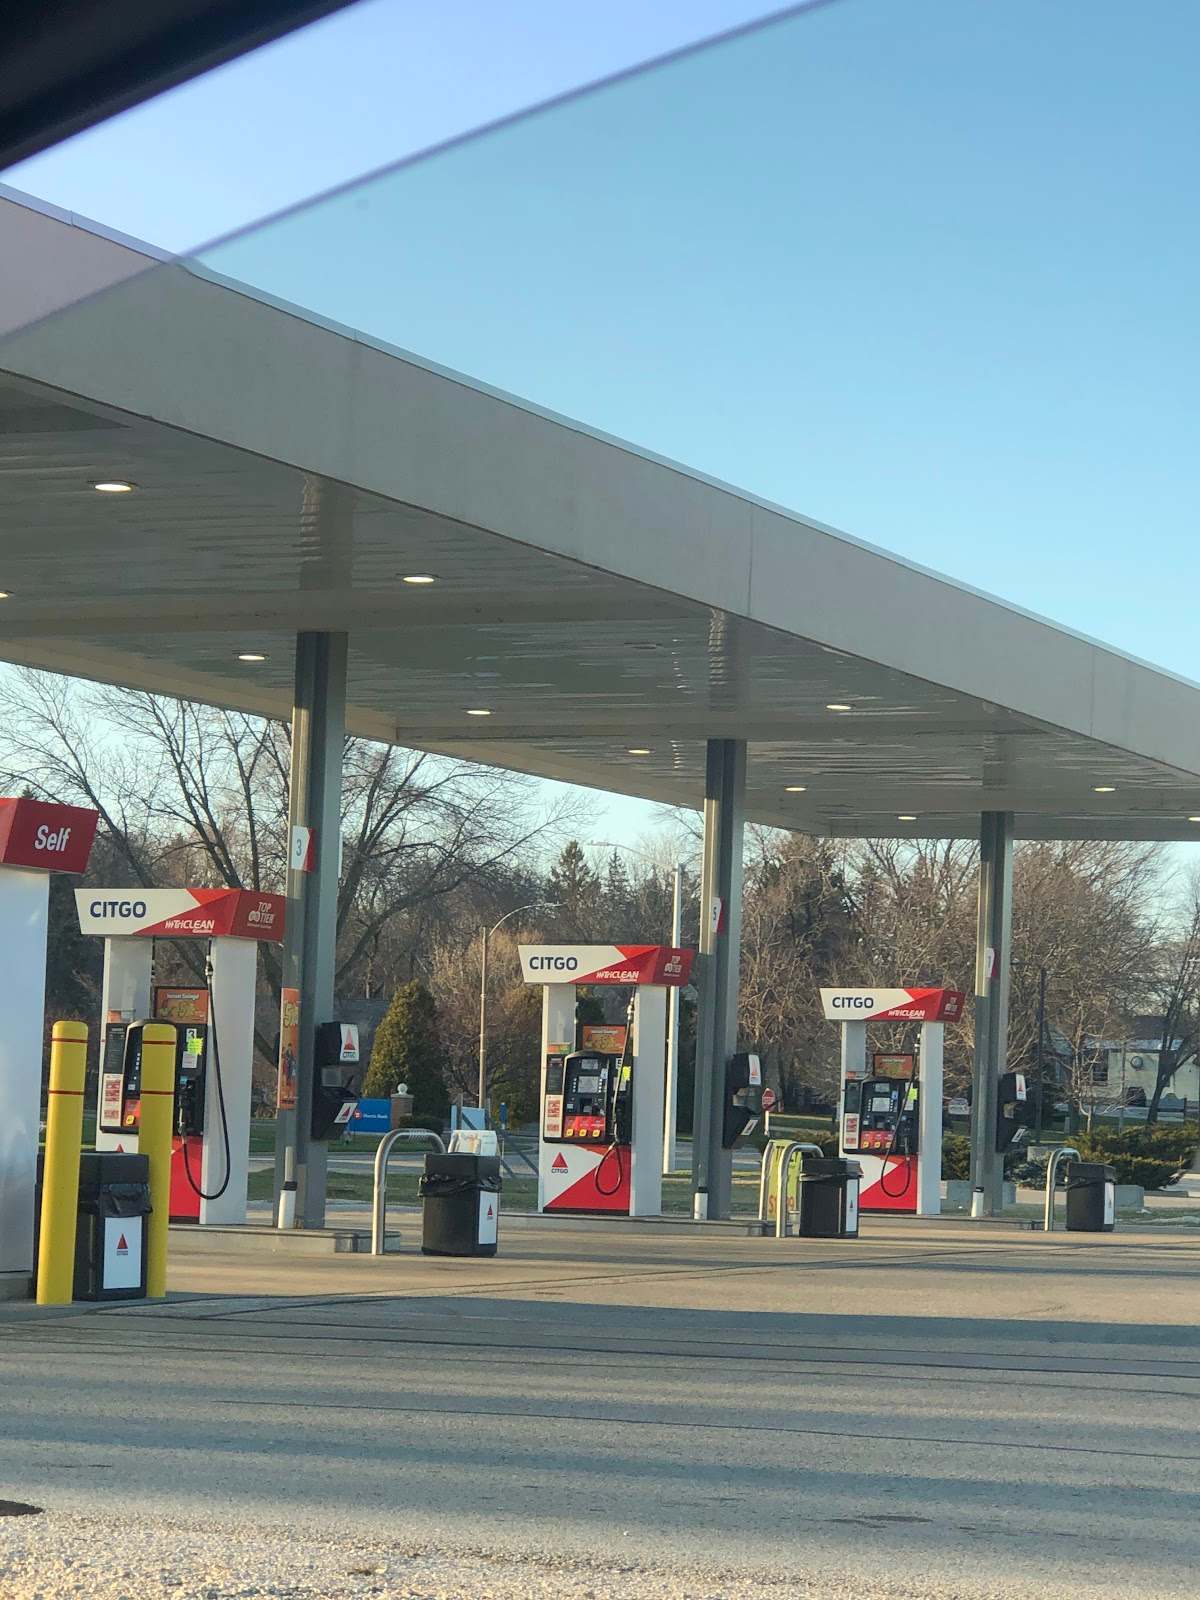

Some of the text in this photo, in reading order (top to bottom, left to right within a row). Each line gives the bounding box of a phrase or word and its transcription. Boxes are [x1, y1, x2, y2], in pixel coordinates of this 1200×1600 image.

[35, 824, 71, 852] Self
[296, 839, 302, 856] 3
[90, 901, 147, 918] CITGO
[257, 902, 271, 913] TOP
[260, 912, 274, 924] TIER
[529, 956, 578, 971] CITGO
[832, 997, 874, 1009] CITGO
